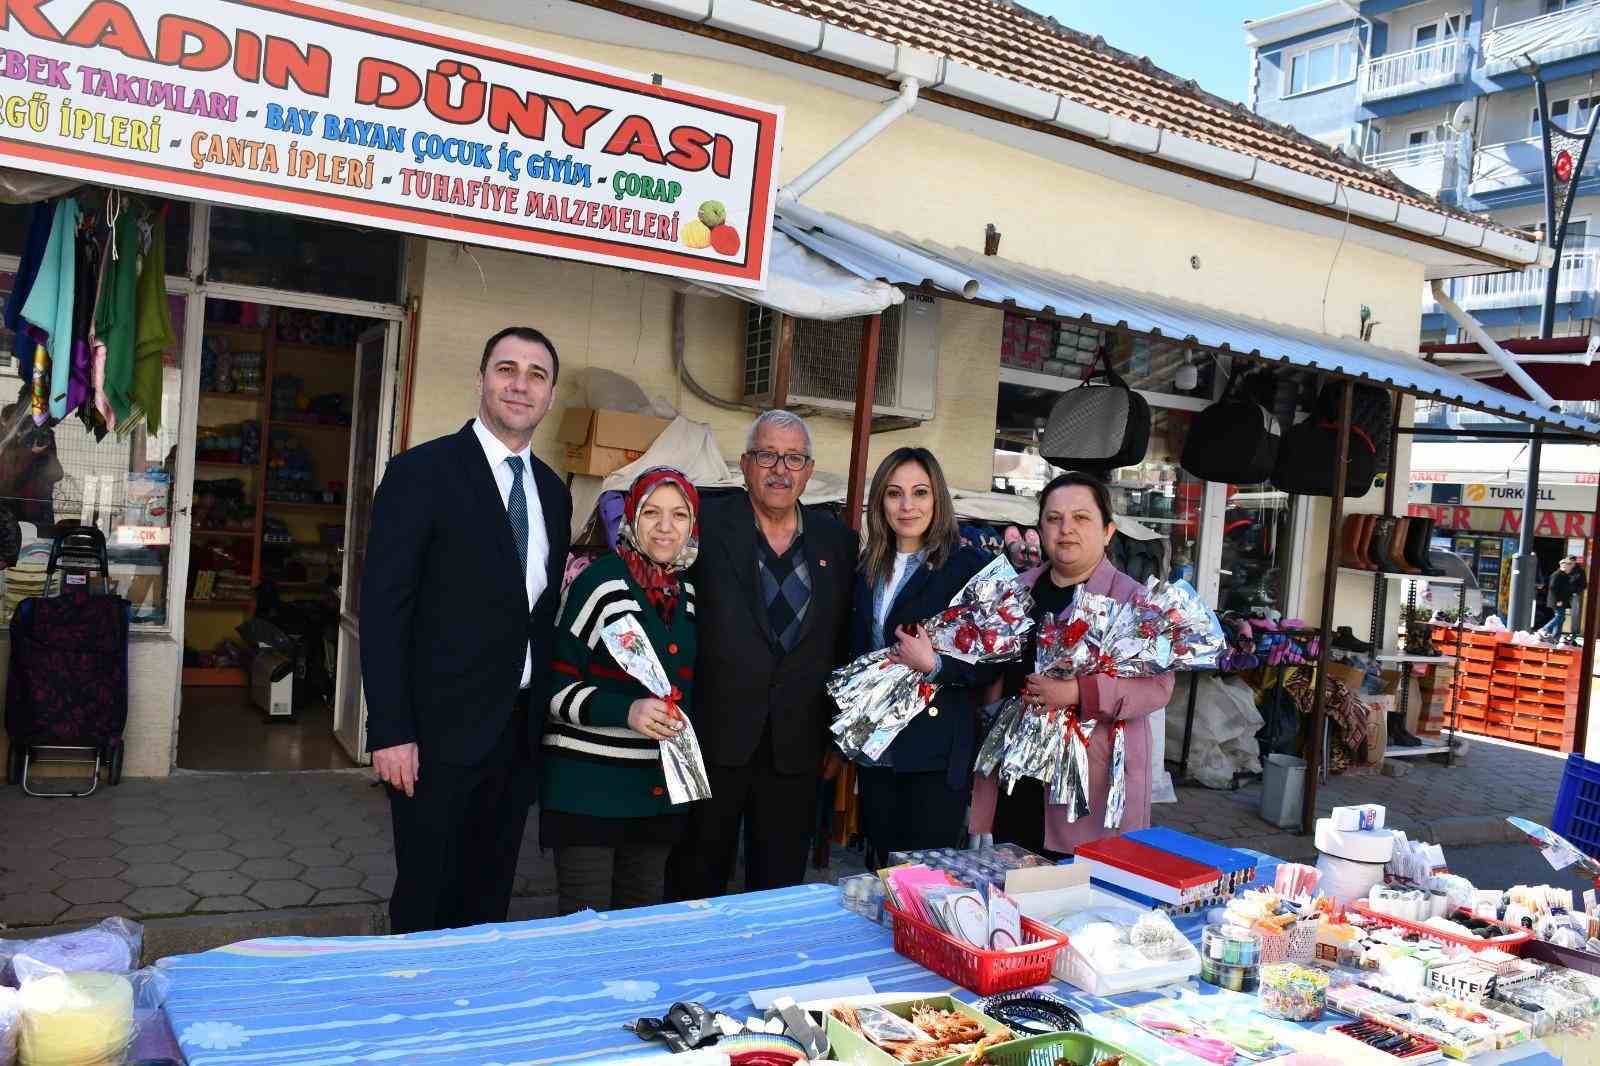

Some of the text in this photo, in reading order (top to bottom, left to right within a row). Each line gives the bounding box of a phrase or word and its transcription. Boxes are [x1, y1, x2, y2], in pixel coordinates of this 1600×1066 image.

[0, 0, 734, 180] KADIN DÜNYASI
[0, 47, 71, 90] BEK
[77, 65, 239, 122] TAKIMLARI
[265, 102, 319, 136] BAY
[322, 113, 405, 154] BAYAN
[412, 131, 493, 168] ÇOCUK
[498, 141, 521, 180] İÇ
[527, 150, 593, 188] GİYİM
[612, 169, 682, 204] ÇORAP
[0, 91, 50, 132] GÜ
[59, 97, 162, 153] İPLERİ
[190, 131, 279, 174] ÇANTA
[287, 140, 375, 190] İPLERİ
[399, 167, 519, 215] TUHAFİYE
[524, 190, 681, 242] MALZEMELERİ
[1410, 472, 1448, 482] ARKET
[1490, 486, 1556, 500] TURKELL
[1431, 970, 1479, 993] ELITE
